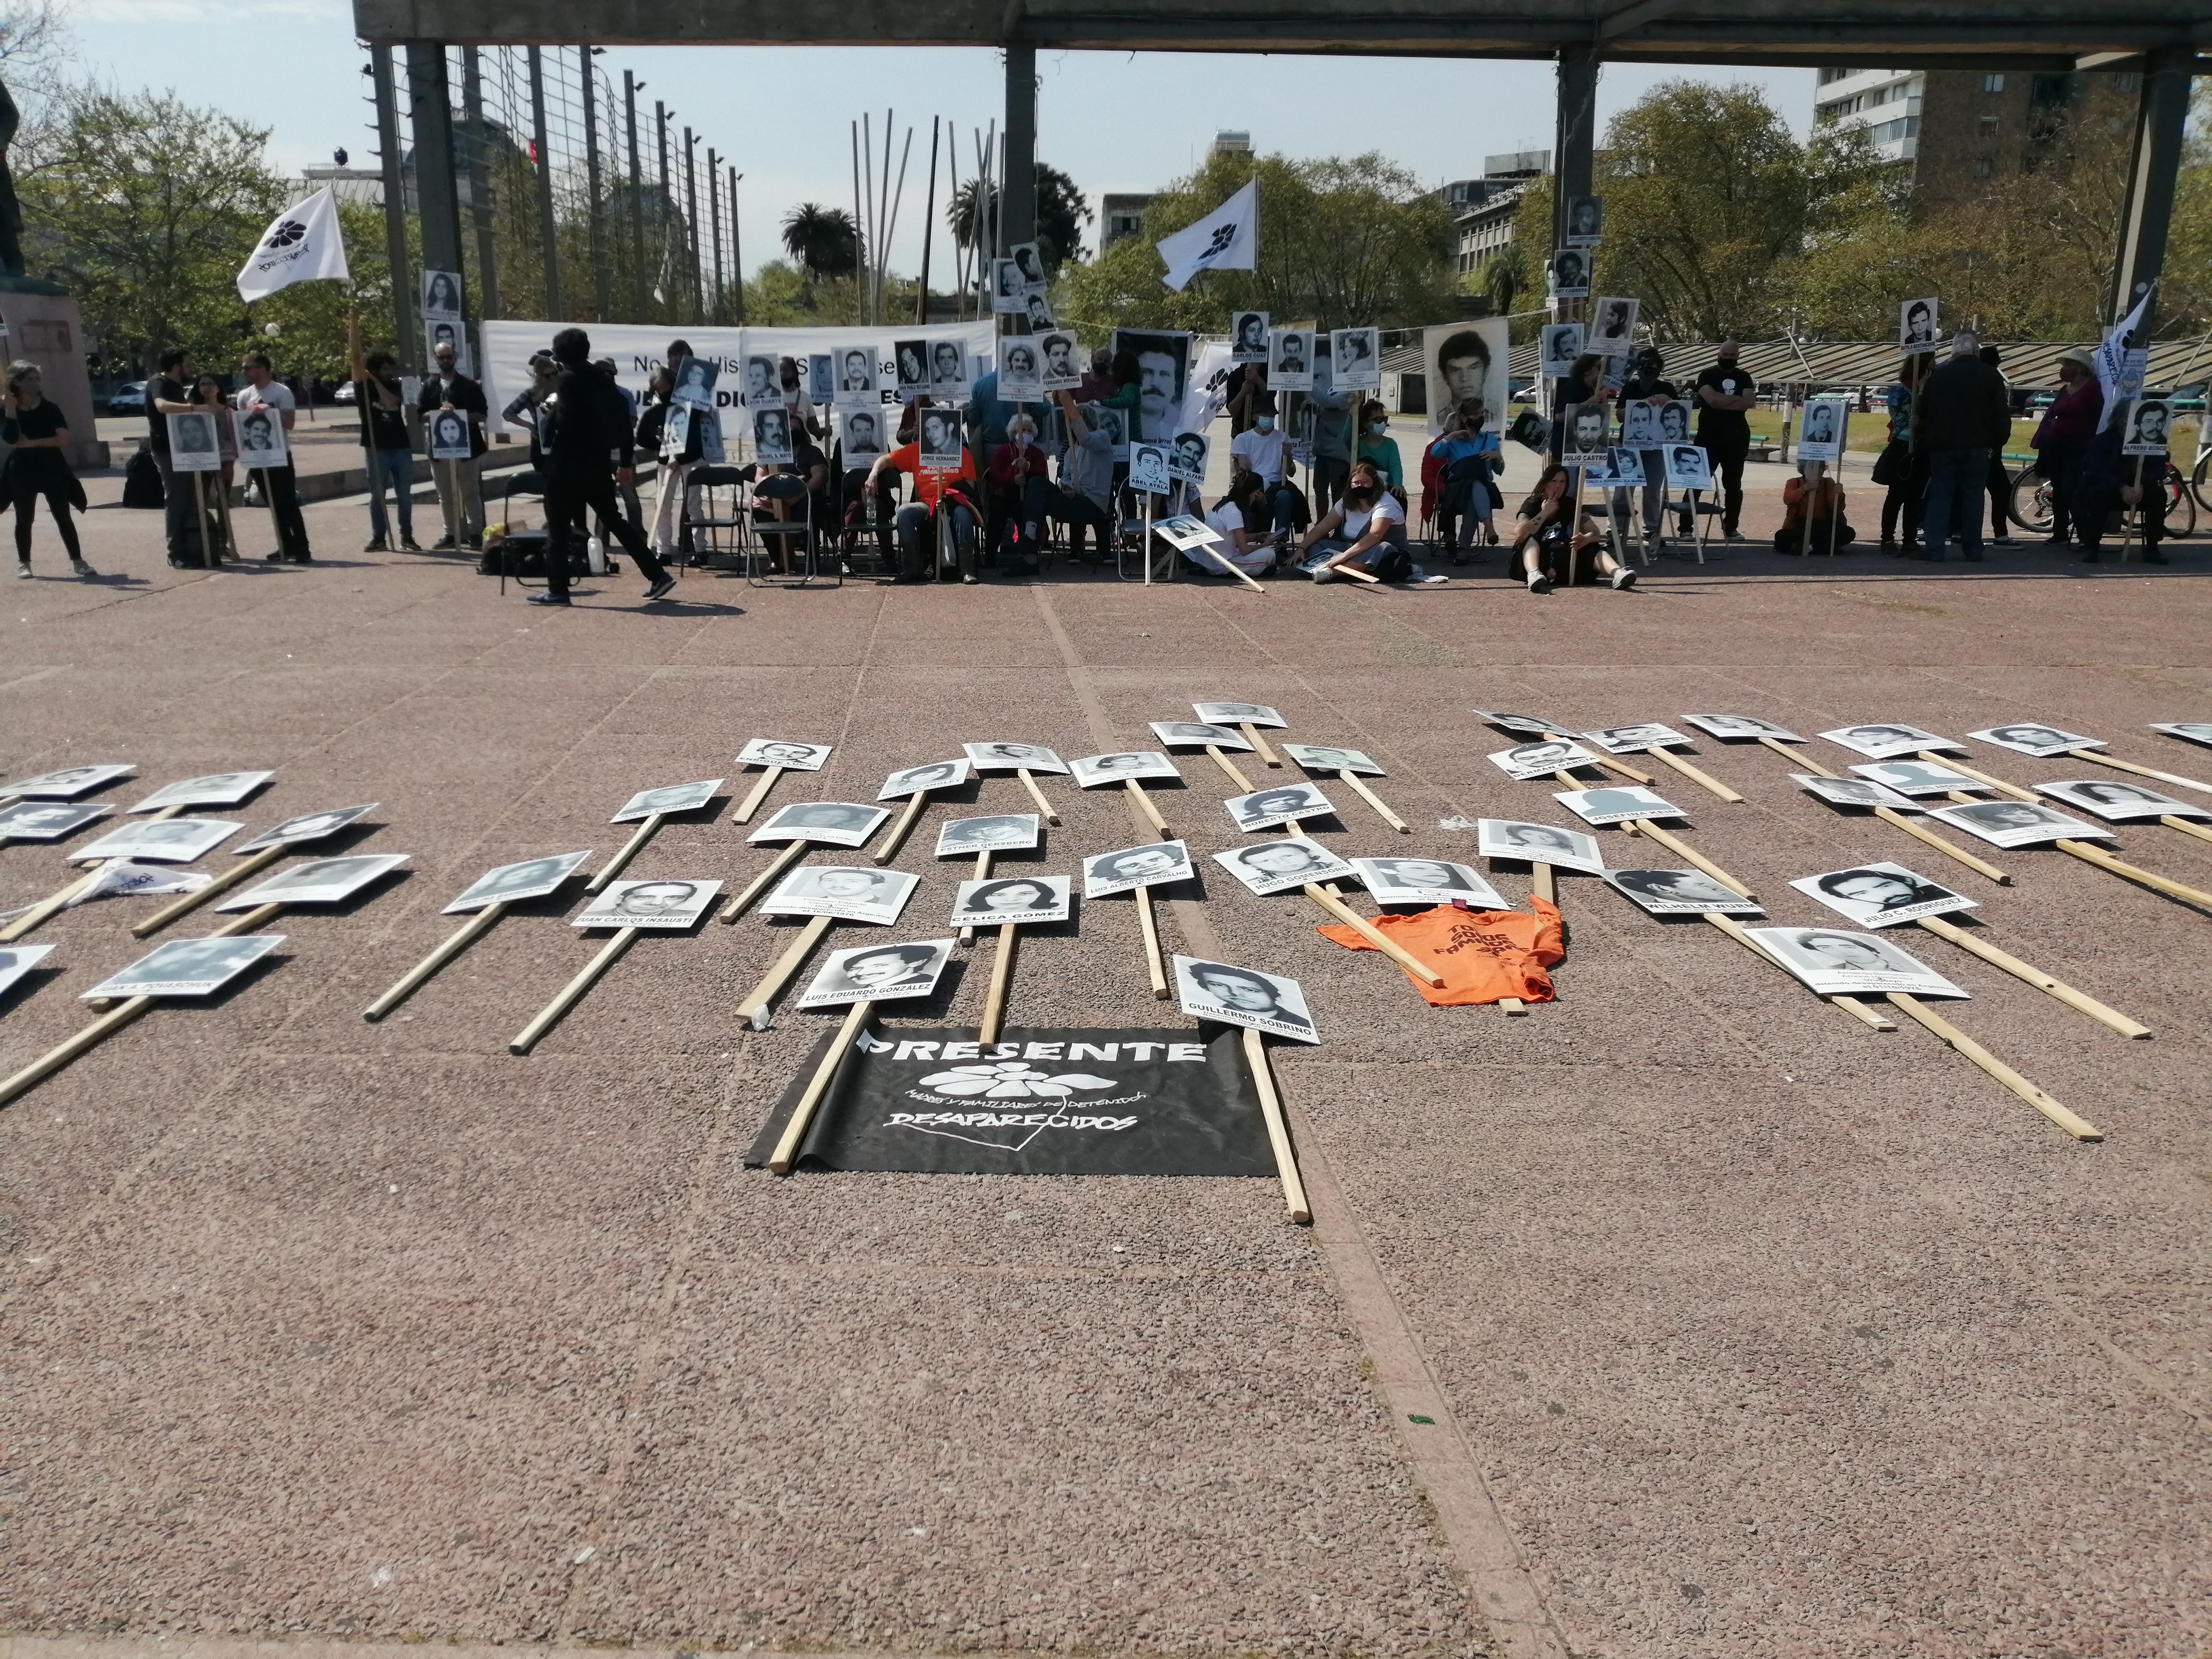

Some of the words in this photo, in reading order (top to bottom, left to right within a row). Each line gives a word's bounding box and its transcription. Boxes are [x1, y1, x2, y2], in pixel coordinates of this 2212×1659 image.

[1167, 466, 1185, 476] DANIEL
[1185, 472, 1204, 481] ALFARO
[882, 786, 921, 797] BEATRIZ
[923, 778, 961, 788] ANGLET
[655, 802, 700, 813] CORREA
[1245, 814, 1289, 827] ROBERTO
[1291, 806, 1329, 816] CASTRO
[1593, 812, 1647, 821] JOSEFINA
[1110, 877, 1144, 889] ALBERTO
[1146, 870, 1187, 881] CARVALHO
[1255, 879, 1285, 890] HUGO
[1286, 866, 1350, 882] GOMENSORO
[1863, 912, 1893, 923] JULIO
[1904, 898, 1965, 913] RODRÍGUEZ
[830, 988, 876, 999] EDUARDO
[878, 983, 932, 994] GONZÁLEZ
[1188, 1003, 1256, 1022] GUILLERMO
[1259, 1018, 1312, 1035] SOBRINO
[856, 1034, 1208, 1062] PRESENTE
[904, 1089, 951, 1104] MADRES
[958, 1099, 1041, 1109] FAMILIARES
[1067, 1091, 1147, 1108] DETENIDOS
[883, 1112, 1139, 1131] DESAPARECIDOS
